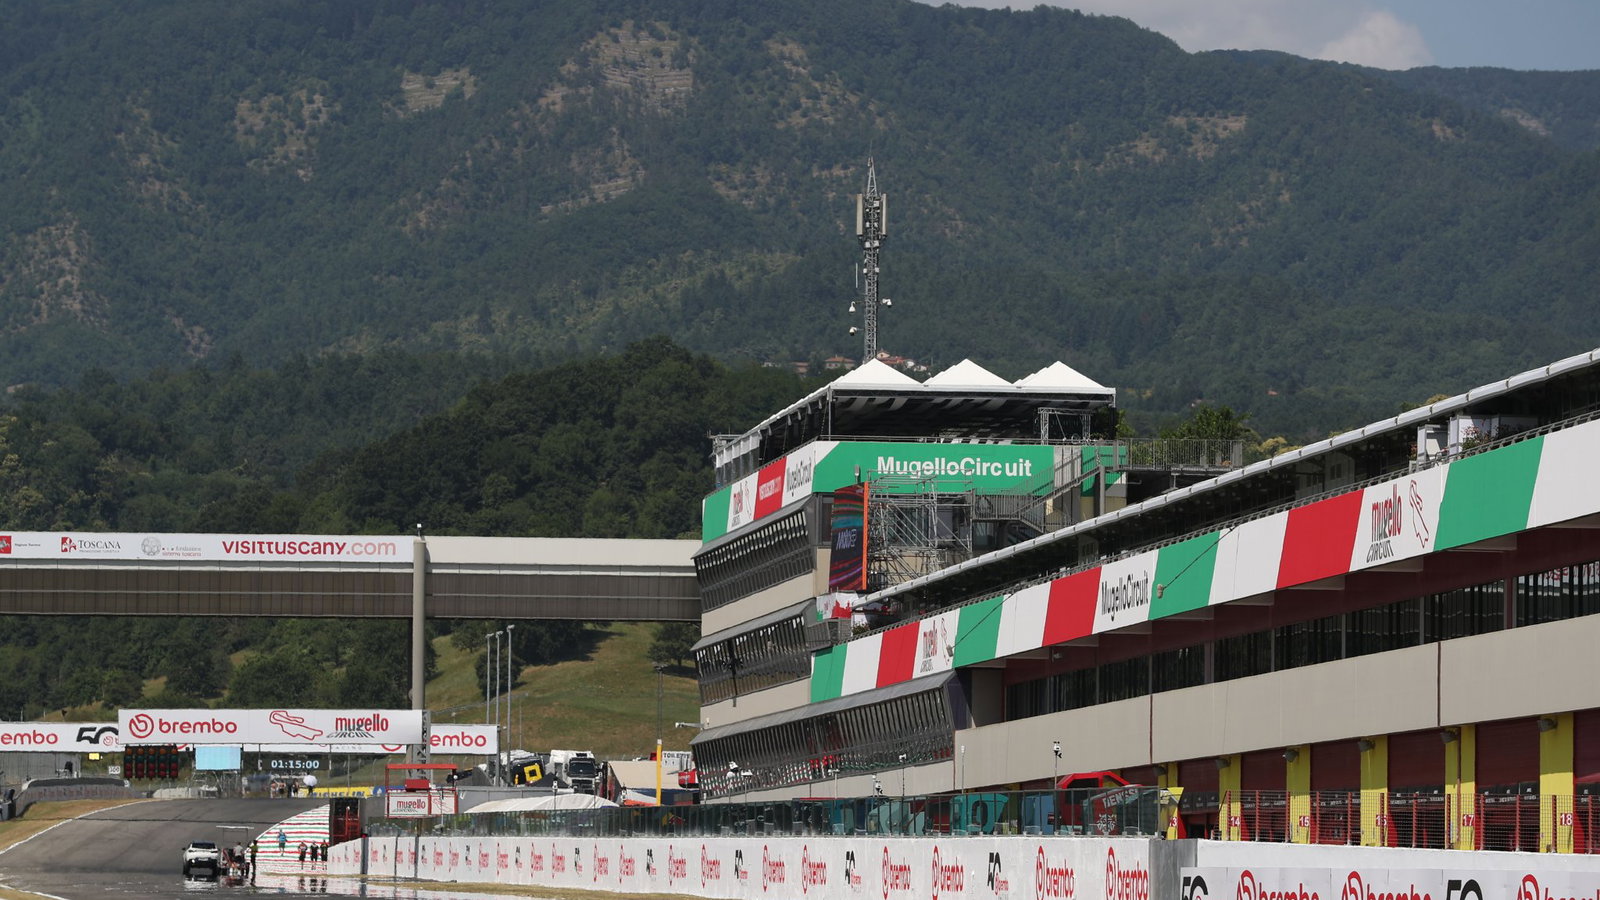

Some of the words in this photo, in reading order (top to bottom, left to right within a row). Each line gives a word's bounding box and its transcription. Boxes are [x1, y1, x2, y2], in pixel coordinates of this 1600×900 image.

[877, 456, 1032, 479] MugelloCircuit
[1371, 483, 1402, 542] mugello
[78, 540, 121, 549] TOSCANA
[1366, 540, 1394, 563] CIRCUIT
[1101, 570, 1149, 622] MugelloCircuit
[158, 718, 238, 734] brembo
[335, 713, 389, 732] mugello
[271, 759, 320, 769] 01:15:00
[1046, 858, 1075, 898] brembo
[1117, 860, 1149, 900] brembo
